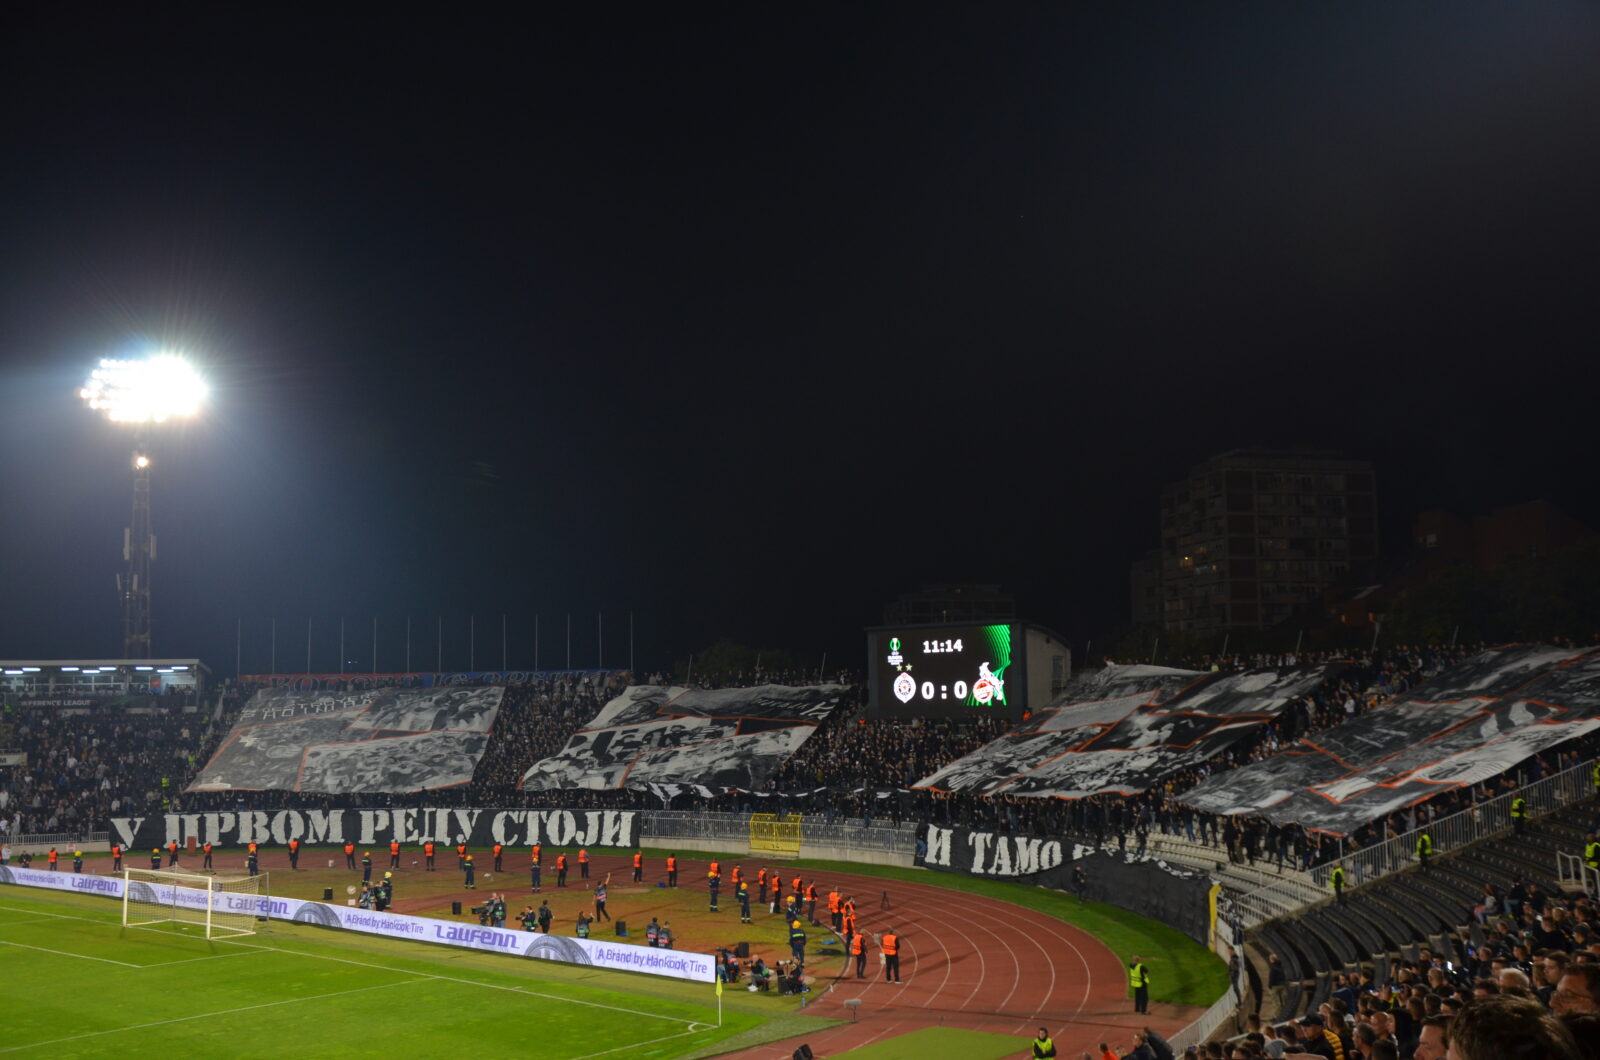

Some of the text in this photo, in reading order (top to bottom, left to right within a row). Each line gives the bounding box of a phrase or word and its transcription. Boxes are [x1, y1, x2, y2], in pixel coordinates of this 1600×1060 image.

[923, 639, 963, 653] 11:14
[163, 809, 345, 849] ПРВОМ
[359, 808, 483, 847] РЕДУ
[491, 809, 636, 847] СТОЈИ
[968, 831, 1062, 876] ТАМО
[411, 922, 424, 934] Tire
[433, 924, 520, 949] Laufenn
[598, 948, 708, 974] A Brand by Hankook Tire
